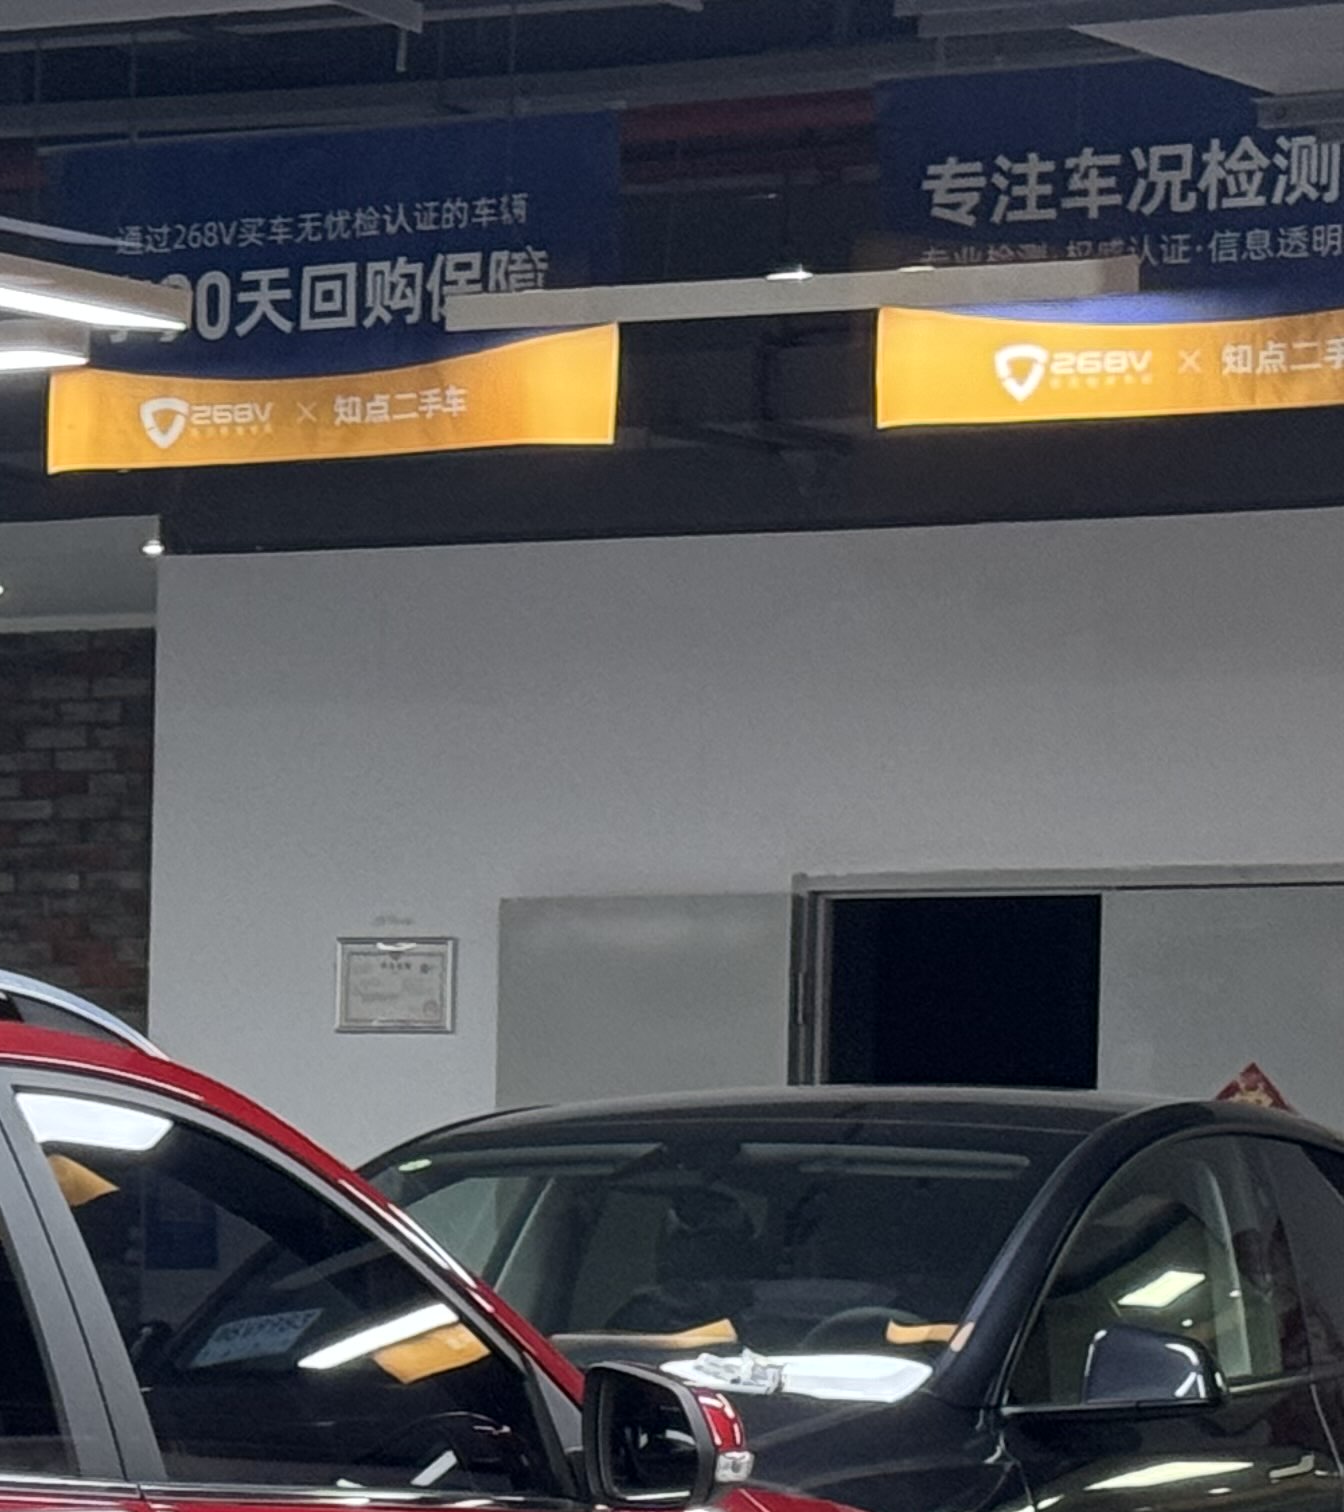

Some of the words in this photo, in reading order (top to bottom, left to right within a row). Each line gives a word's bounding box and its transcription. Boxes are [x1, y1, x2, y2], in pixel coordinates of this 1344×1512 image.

[922, 135, 1342, 228] 专注车况检测
[116, 192, 529, 256] 通过268V买车无忧检认证的车辆
[112, 244, 550, 345] 0天回购保障
[1050, 349, 1153, 376] 268V
[189, 401, 273, 425] 268V
[332, 385, 468, 427] 知点二手车
